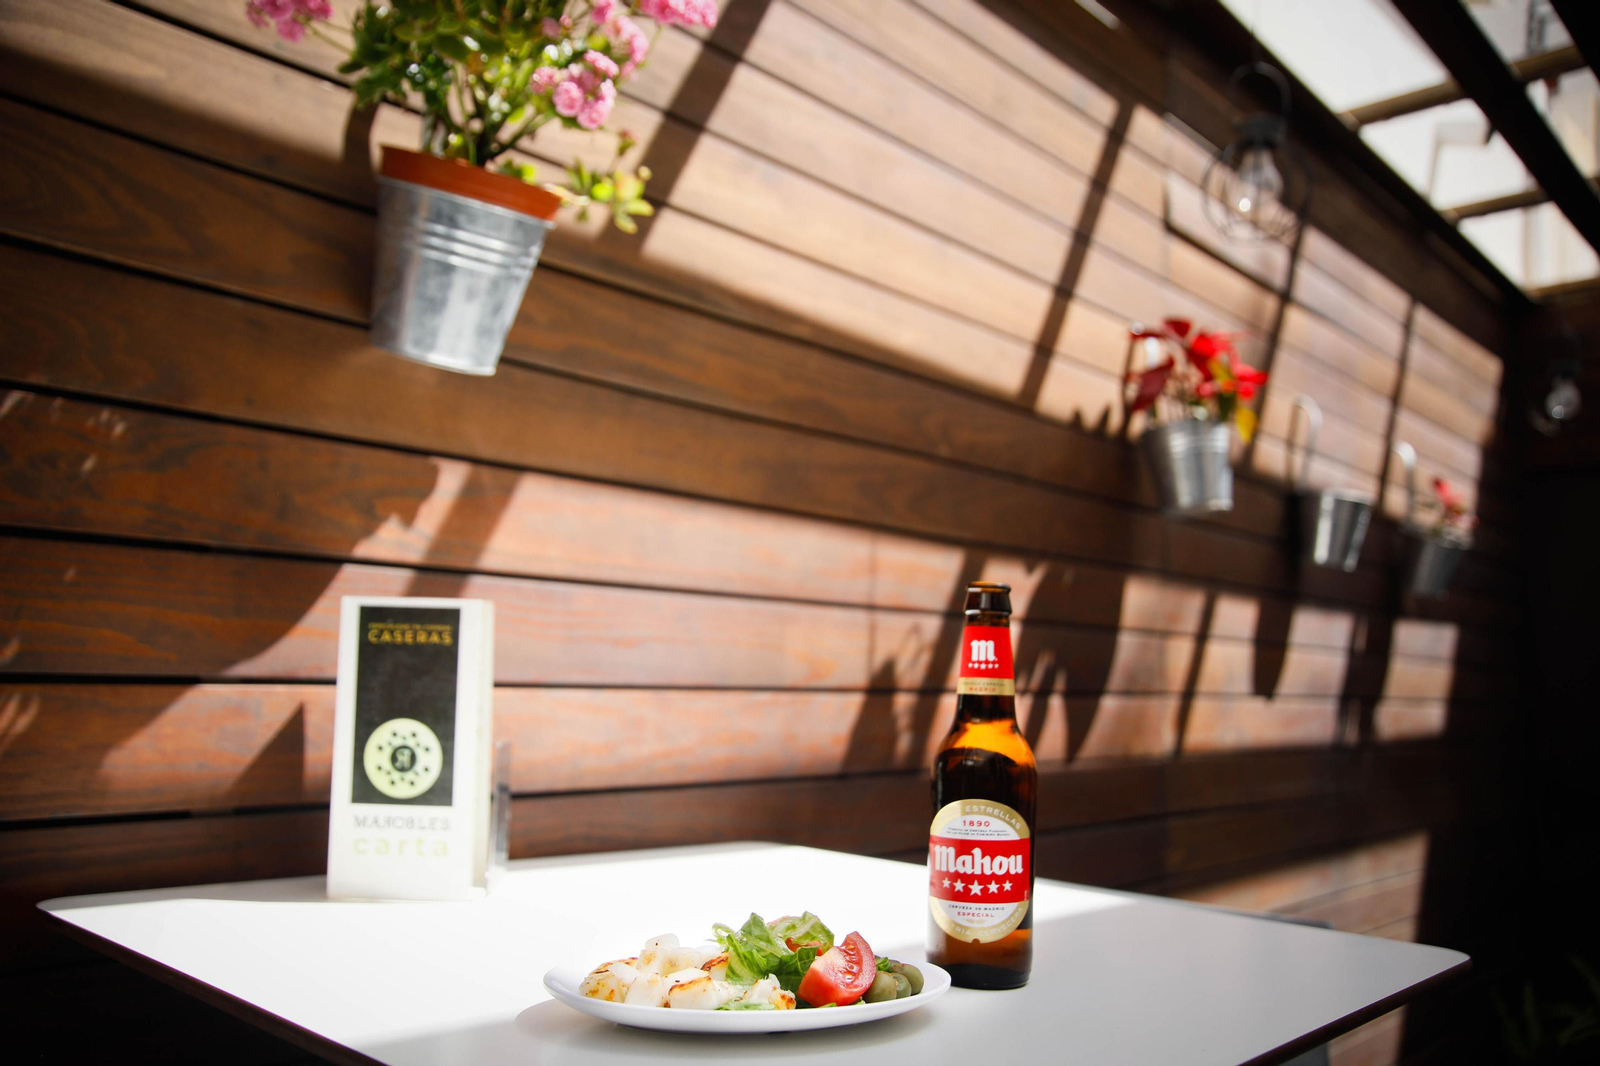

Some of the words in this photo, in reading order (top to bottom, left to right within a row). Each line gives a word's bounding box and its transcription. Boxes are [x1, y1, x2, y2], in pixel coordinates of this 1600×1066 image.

[367, 629, 453, 646] CASERAS
[962, 819, 990, 827] 1890
[965, 805, 1022, 830] ESTRELLAS
[352, 837, 449, 857] carta
[934, 844, 1024, 876] Mahou
[976, 907, 1024, 937] CERVECERA
